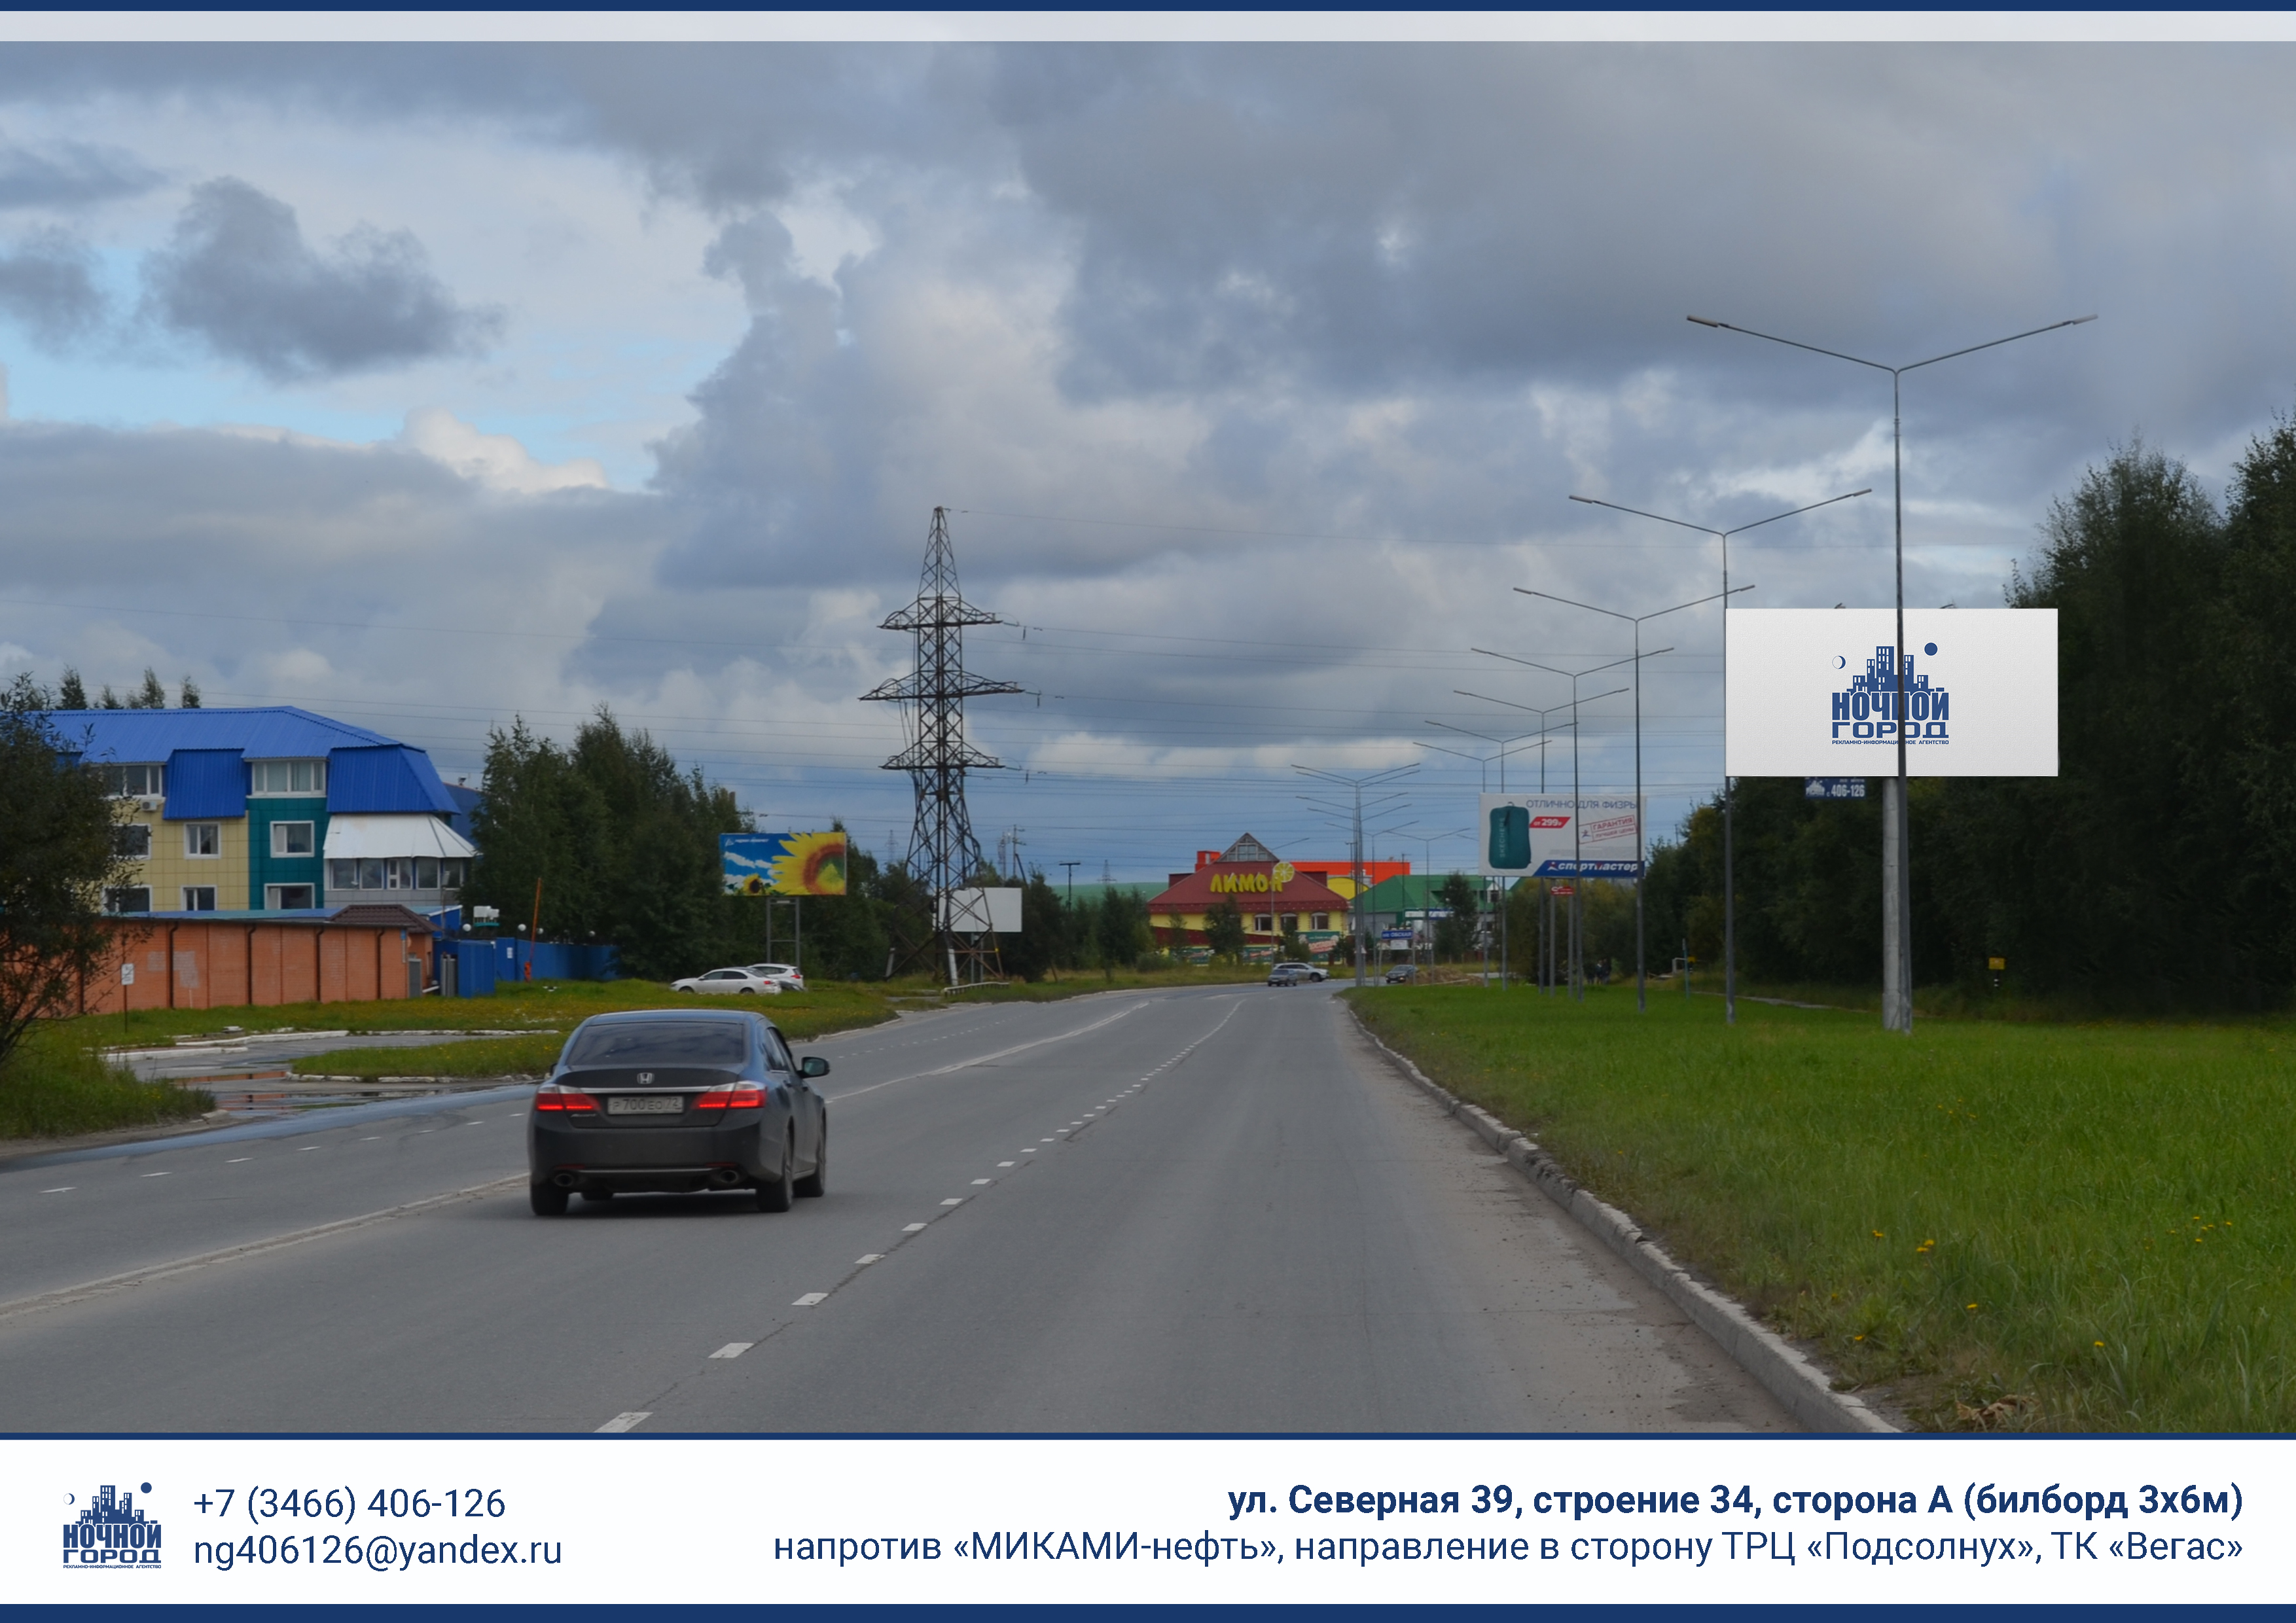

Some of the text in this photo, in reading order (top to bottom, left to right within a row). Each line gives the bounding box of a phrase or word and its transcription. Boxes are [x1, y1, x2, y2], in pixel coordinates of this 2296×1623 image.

[1833, 688, 1949, 721] НОЧНОЙ
[1832, 722, 1949, 738] ГОРОД
[1831, 784, 1865, 797] 406-126
[1526, 800, 1575, 809] ОТЛИЧНО
[1577, 800, 1599, 810] ДЛЯ
[1592, 817, 1634, 830] ГАРАНТИЯ
[1210, 872, 1283, 893] ЛИМОН
